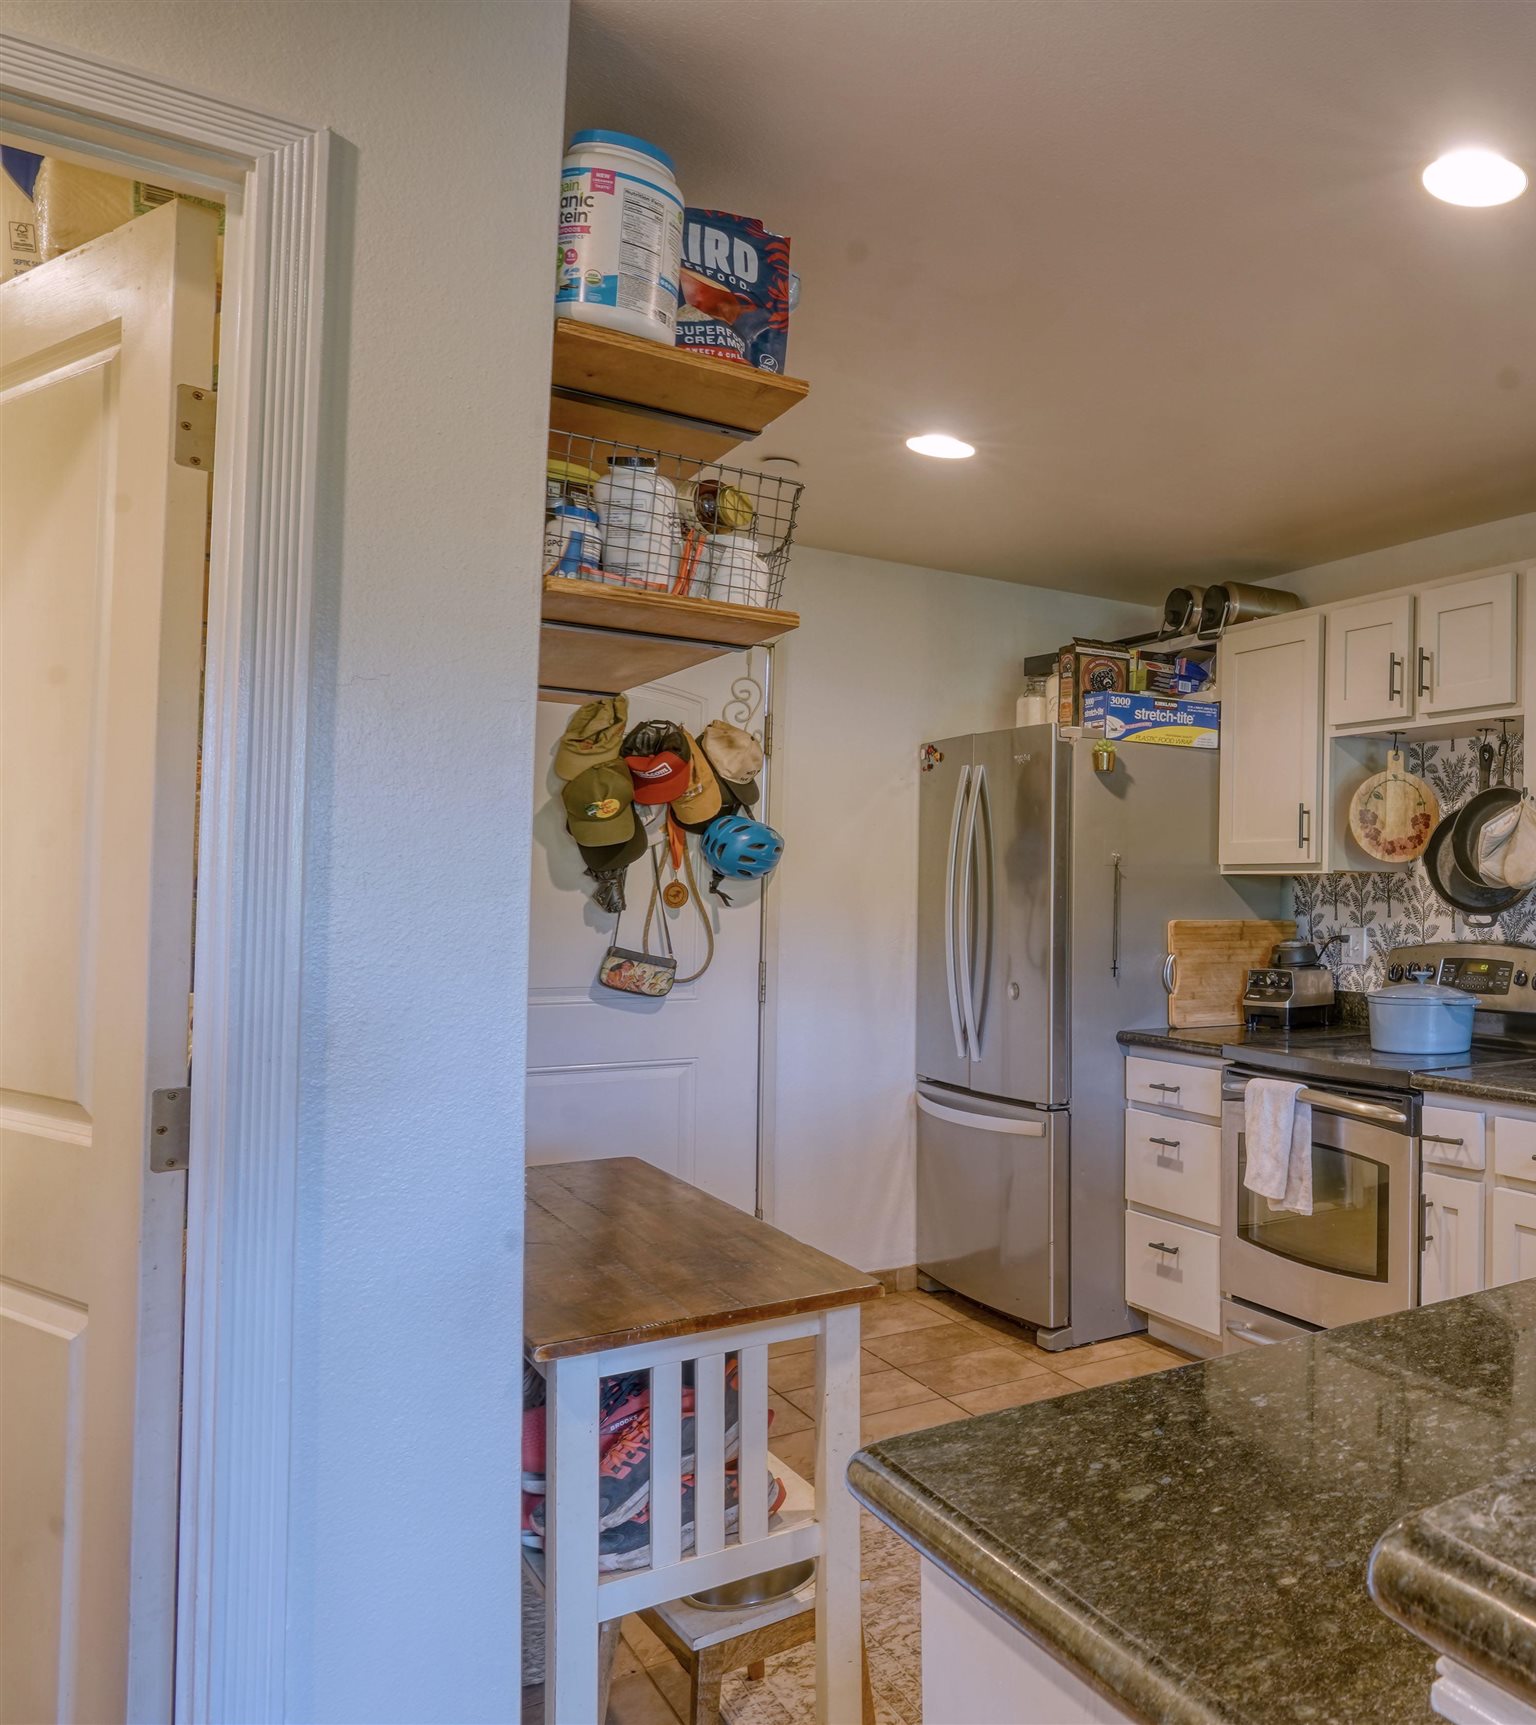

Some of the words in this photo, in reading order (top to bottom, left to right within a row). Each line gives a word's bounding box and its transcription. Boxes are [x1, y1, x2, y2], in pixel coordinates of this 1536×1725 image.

[681, 222, 759, 283] IRD
[675, 325, 745, 347] SUPERFO
[684, 336, 745, 353] CREAM
[1110, 696, 1131, 706] 3000
[1134, 708, 1194, 725] stretch-tite
